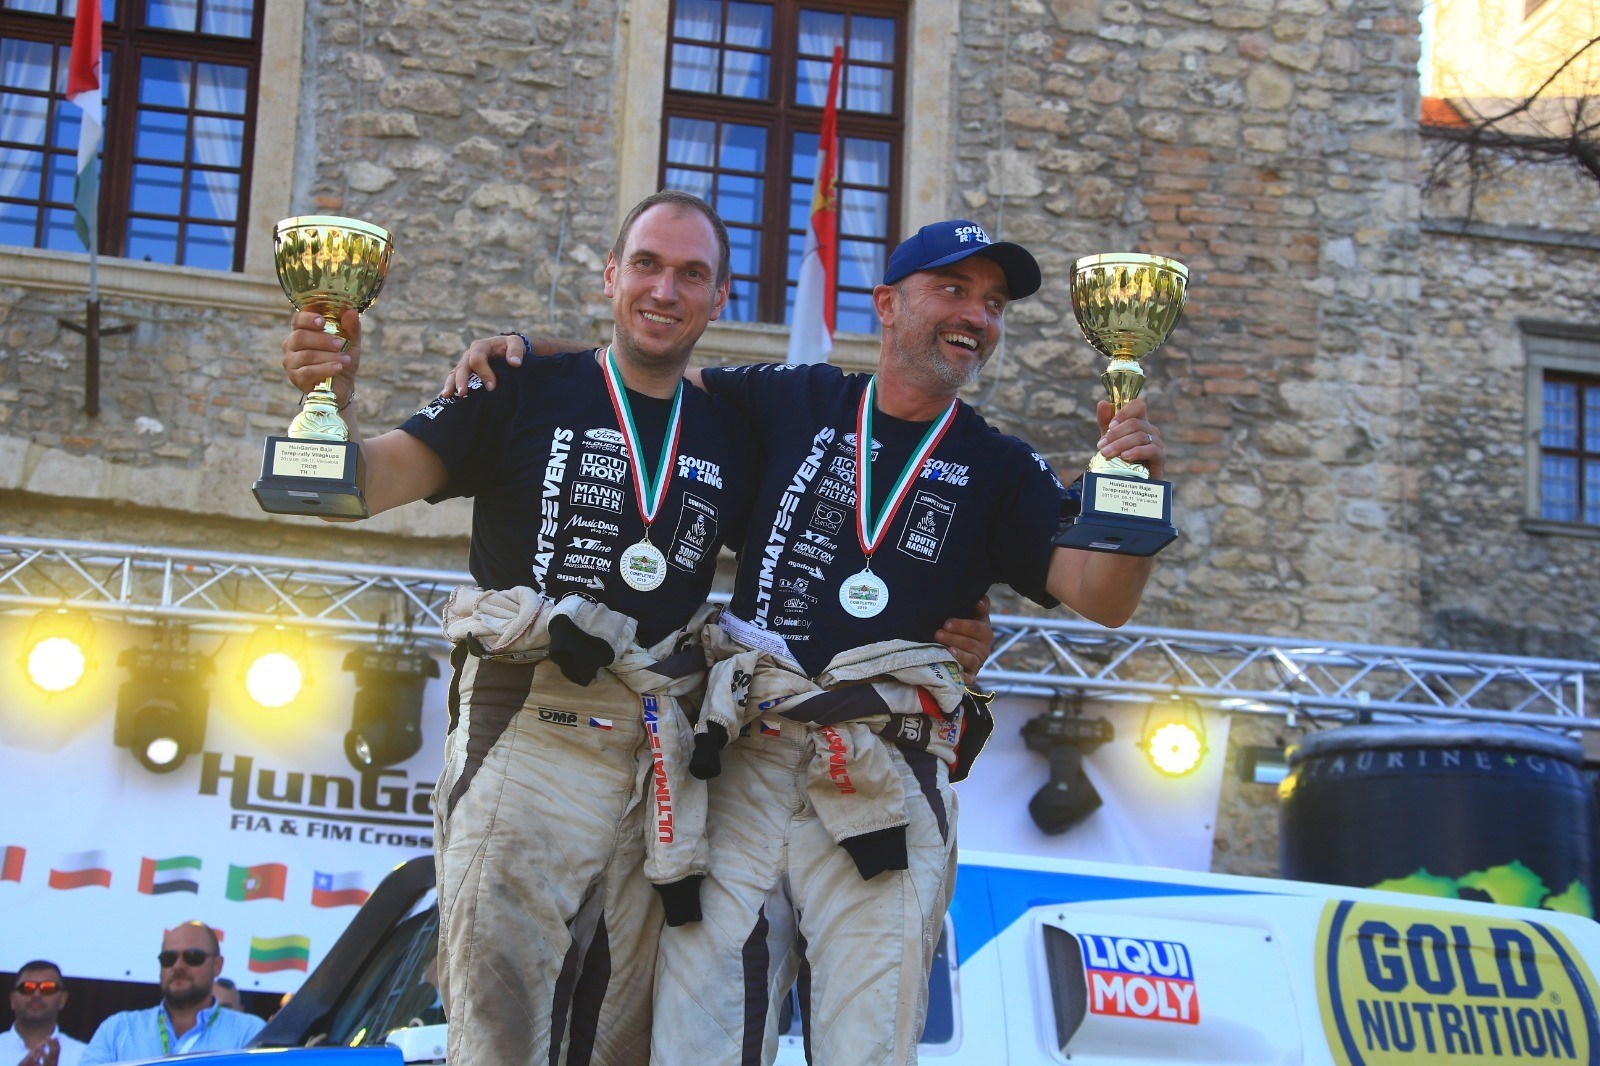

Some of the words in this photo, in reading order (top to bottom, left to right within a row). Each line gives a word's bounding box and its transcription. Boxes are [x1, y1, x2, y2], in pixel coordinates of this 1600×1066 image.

[584, 454, 626, 473] LIQUI
[677, 454, 720, 476] SOUTH
[922, 458, 969, 476] SOUTH
[582, 465, 624, 483] MOLY
[574, 494, 620, 510] FILTER
[575, 484, 621, 502] MANN
[818, 487, 856, 506] FILTER
[566, 536, 612, 552] XTline
[906, 541, 934, 557] RACING
[908, 533, 936, 550] SOUTH
[564, 554, 612, 568] HONITON
[678, 544, 701, 560] SOUTH
[794, 542, 835, 562] HONITON
[674, 554, 695, 570] RACING
[788, 560, 815, 573] agados
[556, 574, 593, 584] agados
[538, 708, 578, 724] OMP
[1310, 750, 1492, 776] TAURINE
[199, 752, 434, 816] HunGa
[230, 814, 272, 832] FIA
[280, 818, 298, 836] &
[306, 822, 352, 842] FIM
[1082, 934, 1190, 978] LIQUI
[1358, 920, 1544, 1000] GOLD
[1092, 973, 1195, 1020] MOLY
[1356, 999, 1578, 1060] NUTRITION
